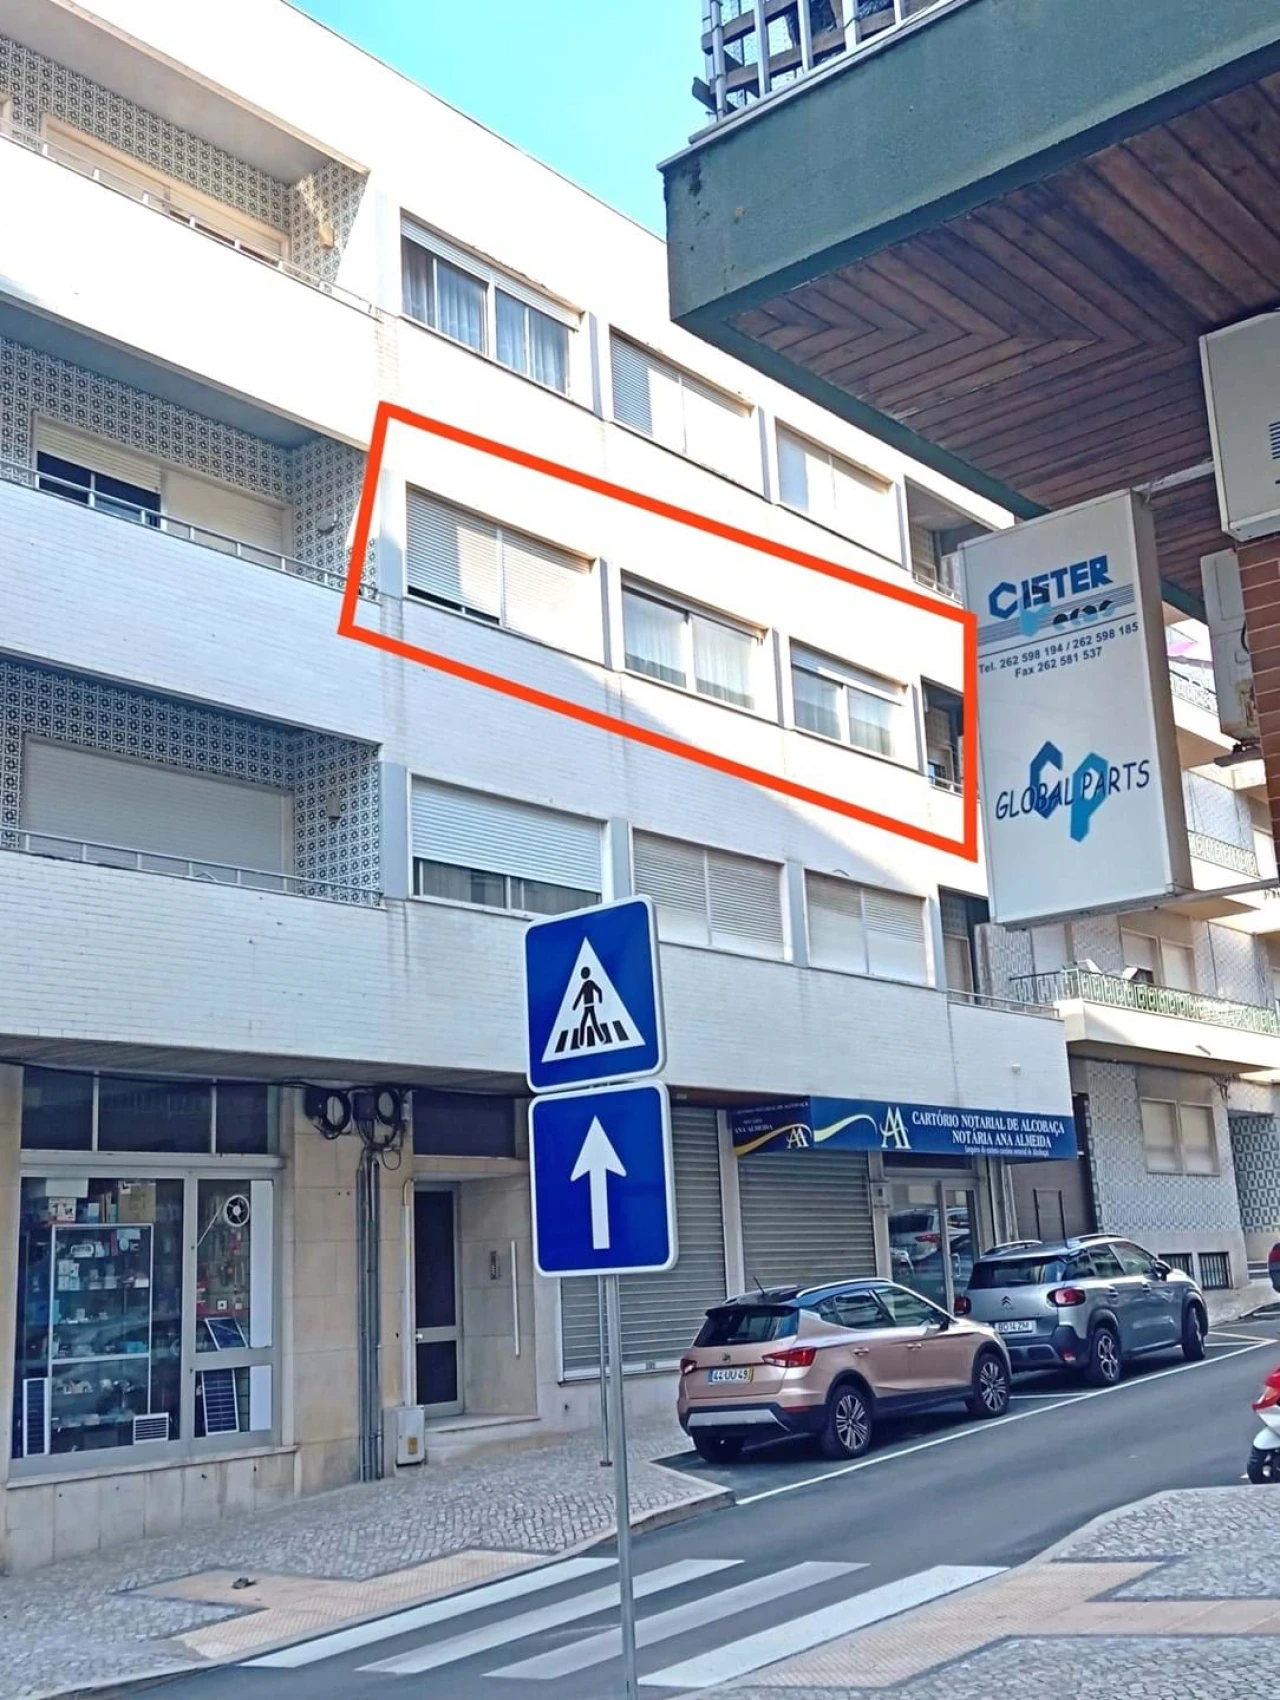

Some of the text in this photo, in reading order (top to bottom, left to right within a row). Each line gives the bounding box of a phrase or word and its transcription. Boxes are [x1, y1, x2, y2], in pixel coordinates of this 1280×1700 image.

[988, 555, 1113, 620] CISTER
[979, 663, 997, 674] Tel.
[1000, 655, 1019, 669] 262
[1022, 649, 1041, 664] 598
[1044, 644, 1064, 657] 194
[1073, 637, 1092, 650] 262
[1096, 629, 1116, 643] 598
[1119, 622, 1139, 636] 185
[1014, 646, 1103, 678] Fax 262 581 537
[995, 759, 1150, 820] GLOBAL PARTS
[912, 1109, 1065, 1137] CARTÓRIO NOTARIAL DE ALCOBAÇA
[952, 1128, 1052, 1149] NOTÁRIA ANA ALMEIDA
